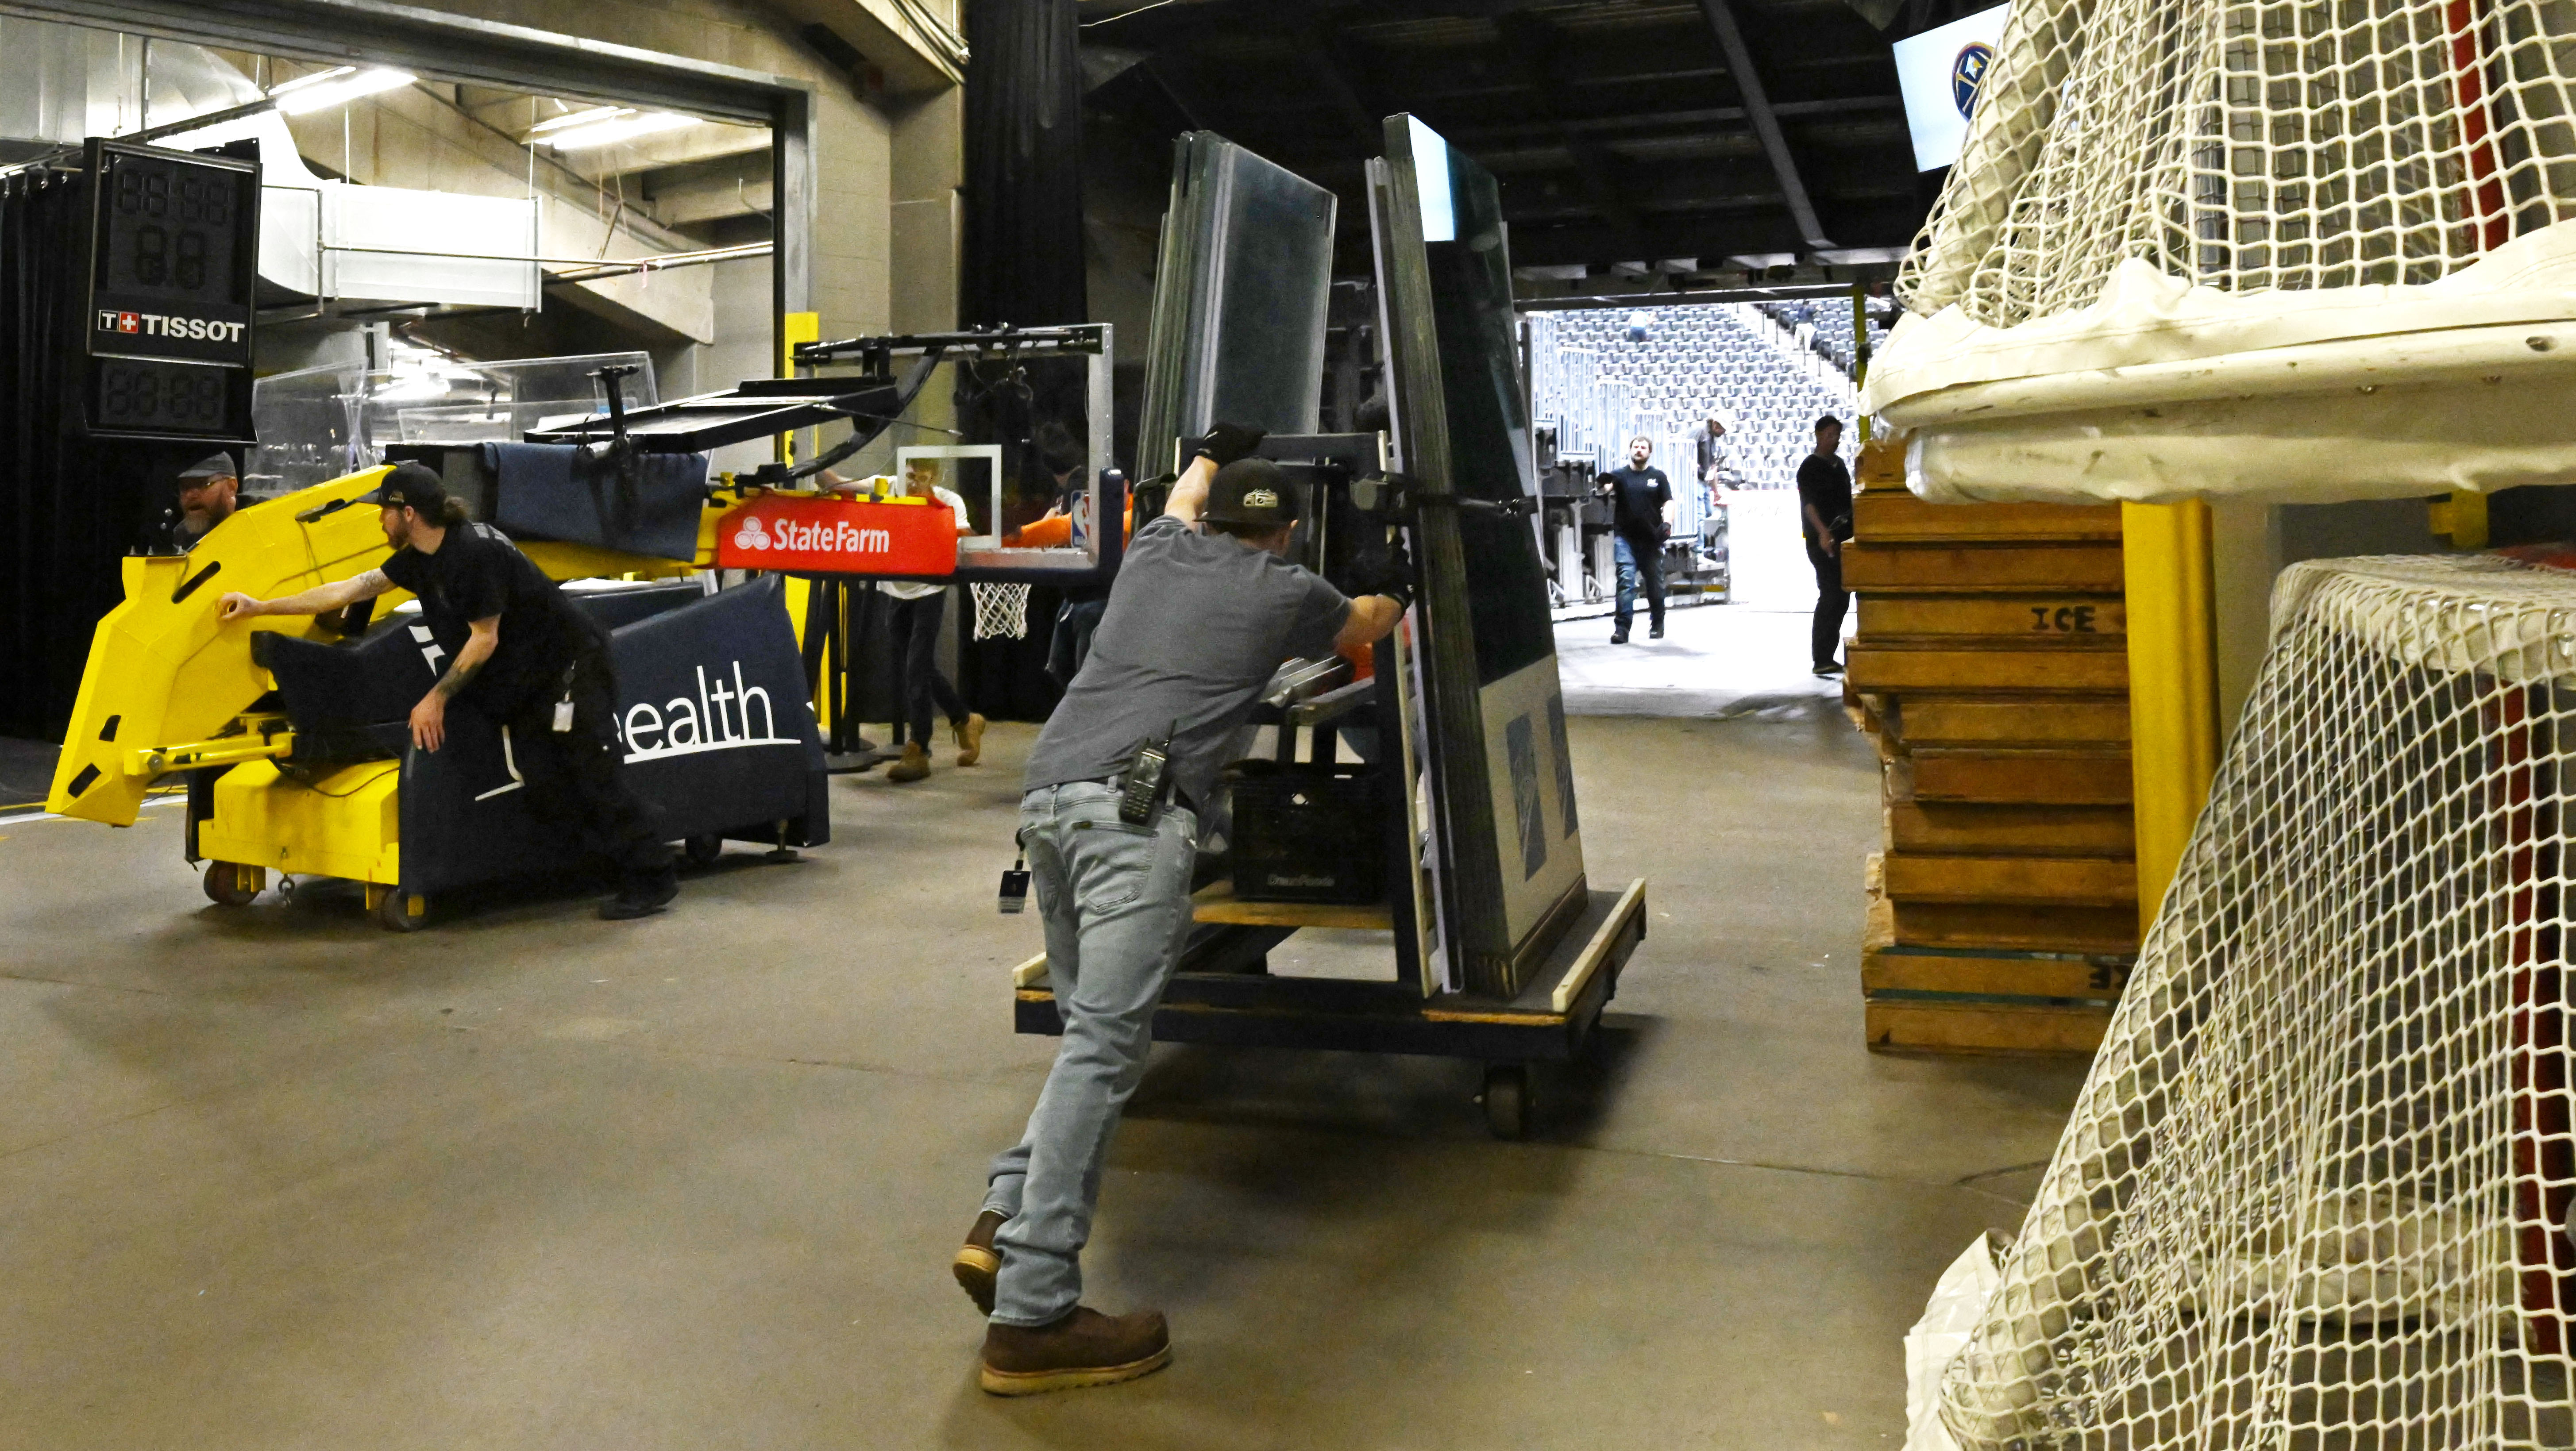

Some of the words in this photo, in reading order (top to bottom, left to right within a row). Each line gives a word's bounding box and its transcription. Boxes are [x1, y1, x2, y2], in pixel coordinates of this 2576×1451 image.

[141, 313, 245, 343] TISSOT
[2031, 606, 2096, 632] ICE
[613, 661, 774, 754] ealth
